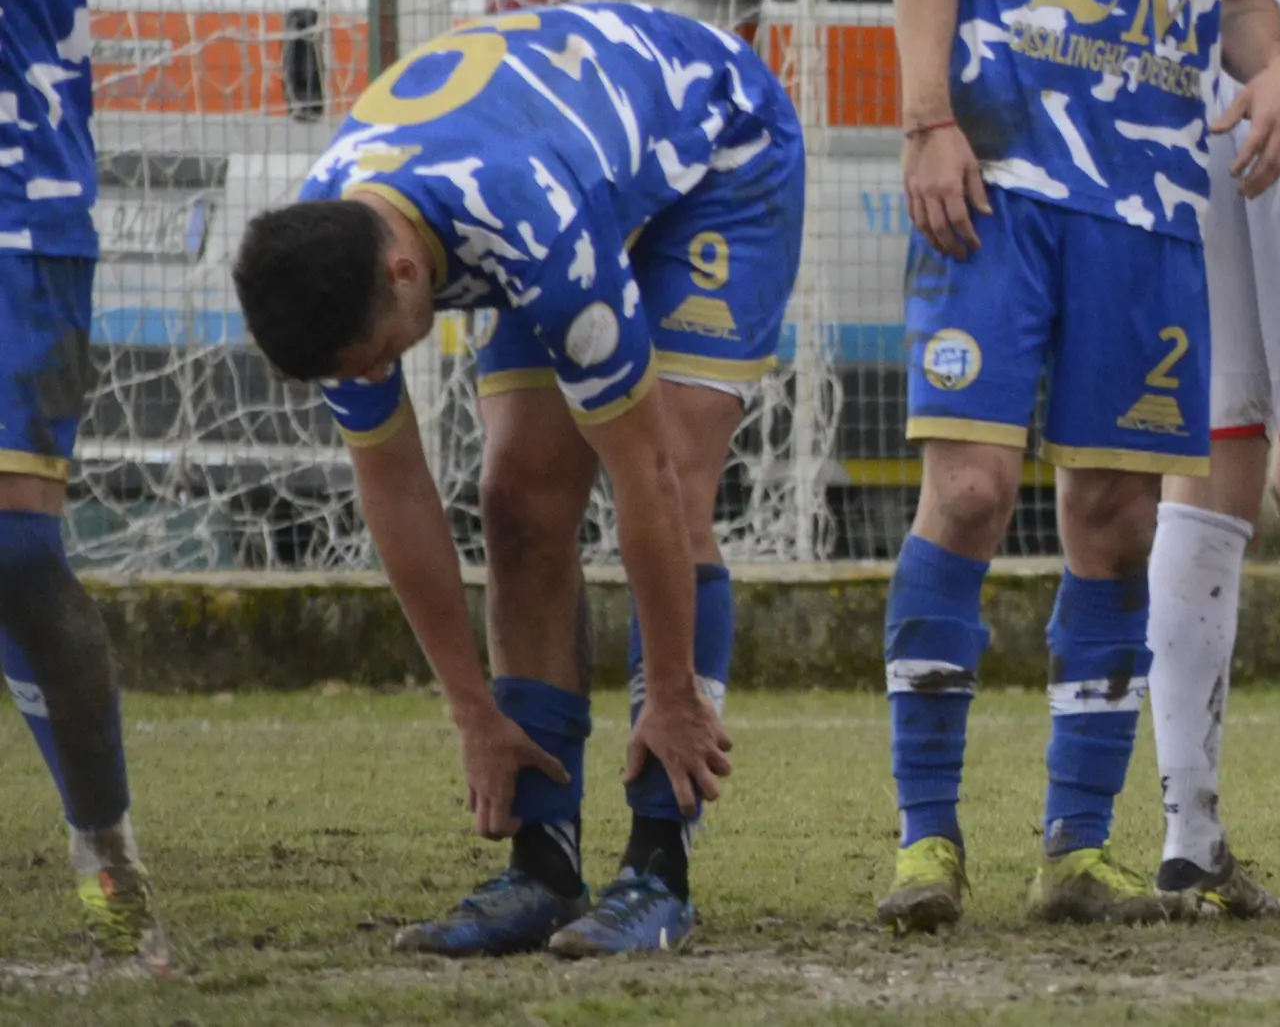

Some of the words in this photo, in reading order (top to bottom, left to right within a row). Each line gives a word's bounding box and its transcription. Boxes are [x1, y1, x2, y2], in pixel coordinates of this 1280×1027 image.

[1009, 19, 1128, 76] CASALINGHI
[688, 230, 730, 291] 9
[1144, 326, 1189, 389] 2
